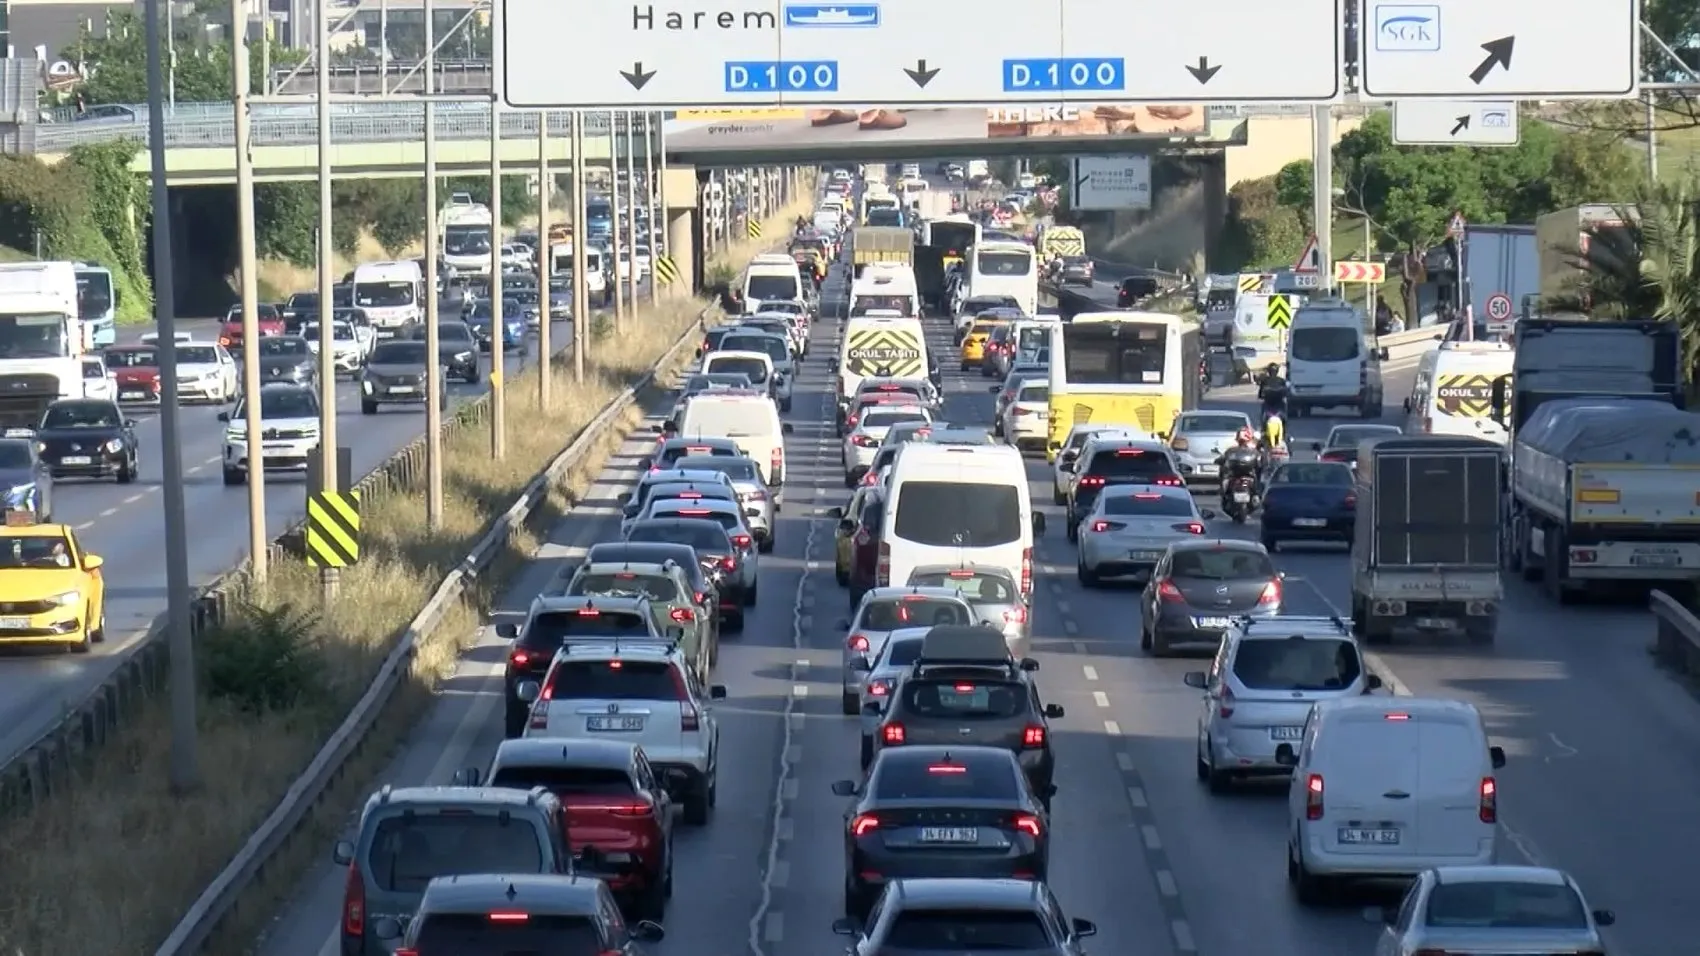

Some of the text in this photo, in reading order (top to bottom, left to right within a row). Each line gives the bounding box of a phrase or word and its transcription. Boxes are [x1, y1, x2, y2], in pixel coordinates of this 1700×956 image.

[633, 5, 775, 30] Harem
[730, 65, 833, 88] D.100
[1012, 62, 1116, 87] D.100
[1492, 300, 1507, 314] 50
[850, 349, 881, 358] OKUL
[1440, 388, 1475, 397] OKUL
